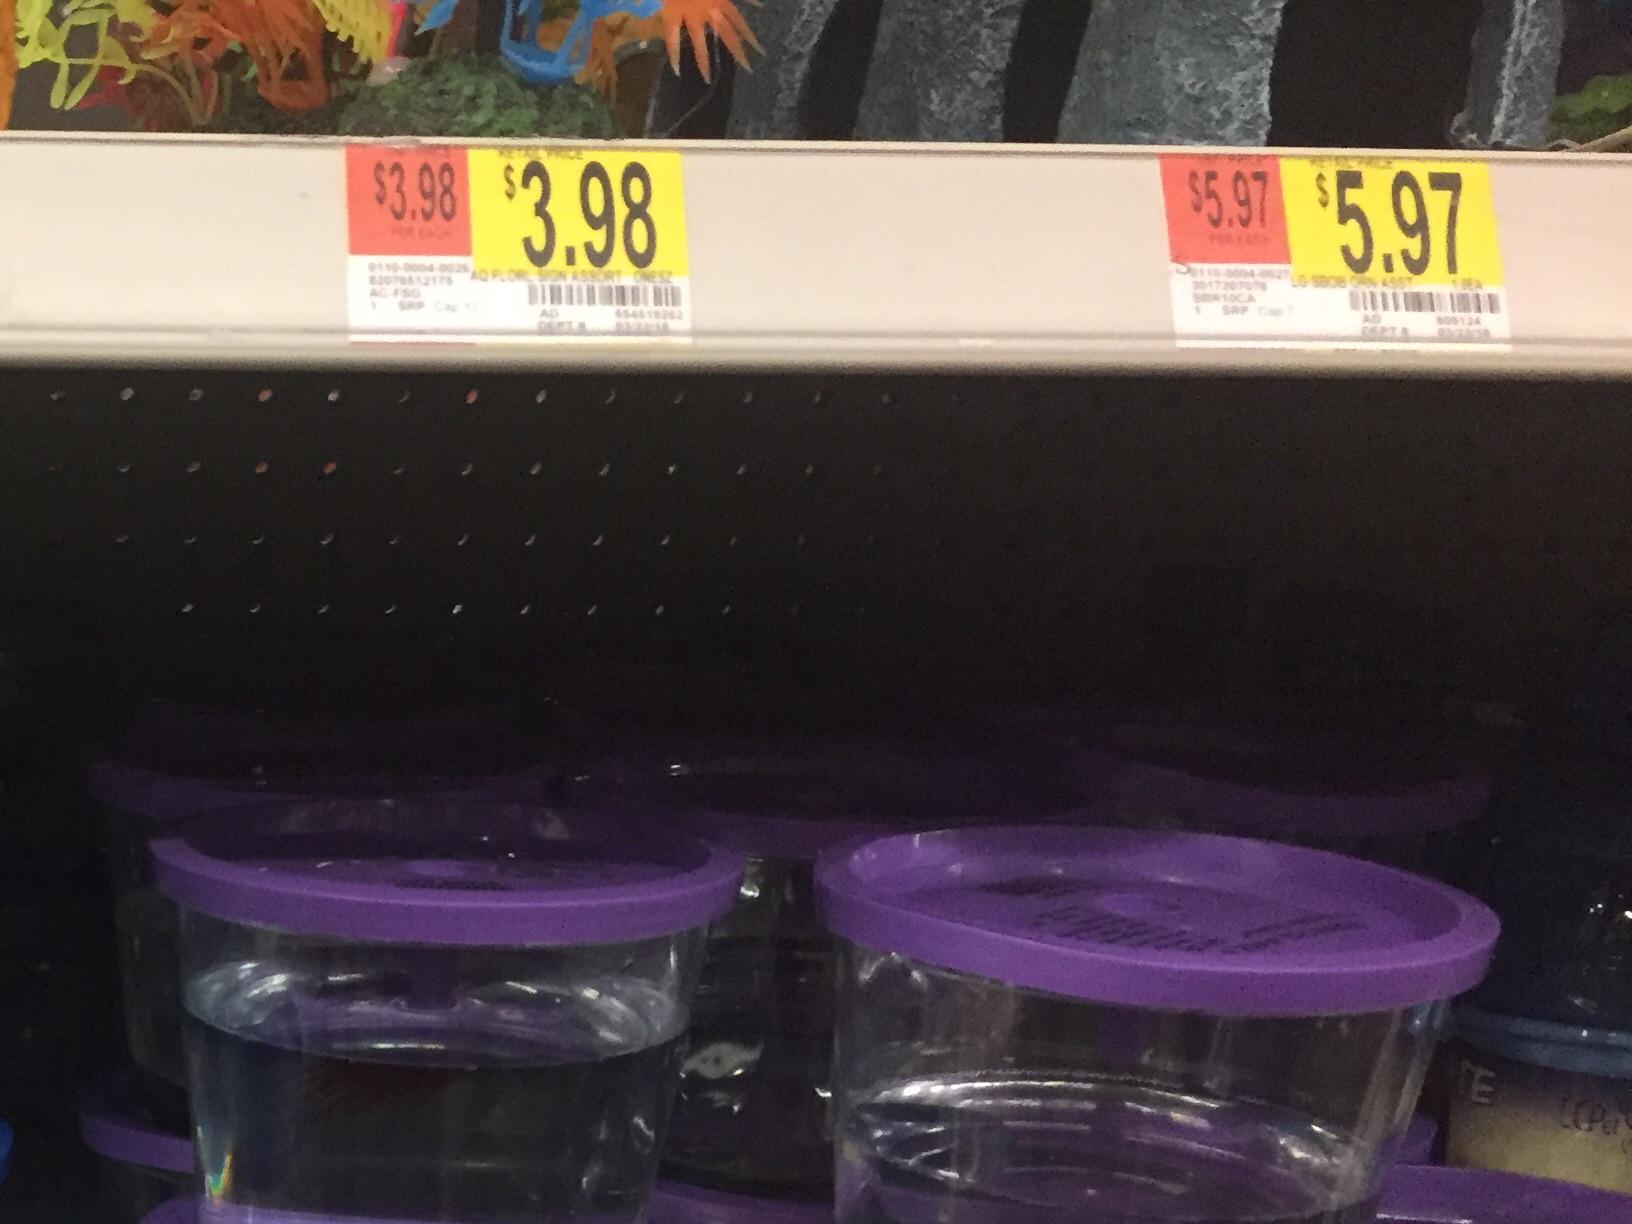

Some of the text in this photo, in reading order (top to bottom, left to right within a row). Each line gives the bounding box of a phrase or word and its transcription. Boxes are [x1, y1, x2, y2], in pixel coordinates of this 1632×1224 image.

[373, 160, 457, 222] $3.98
[504, 160, 658, 269] $3.98
[1188, 169, 1270, 230] $5.97
[1315, 170, 1463, 276] $5.97
